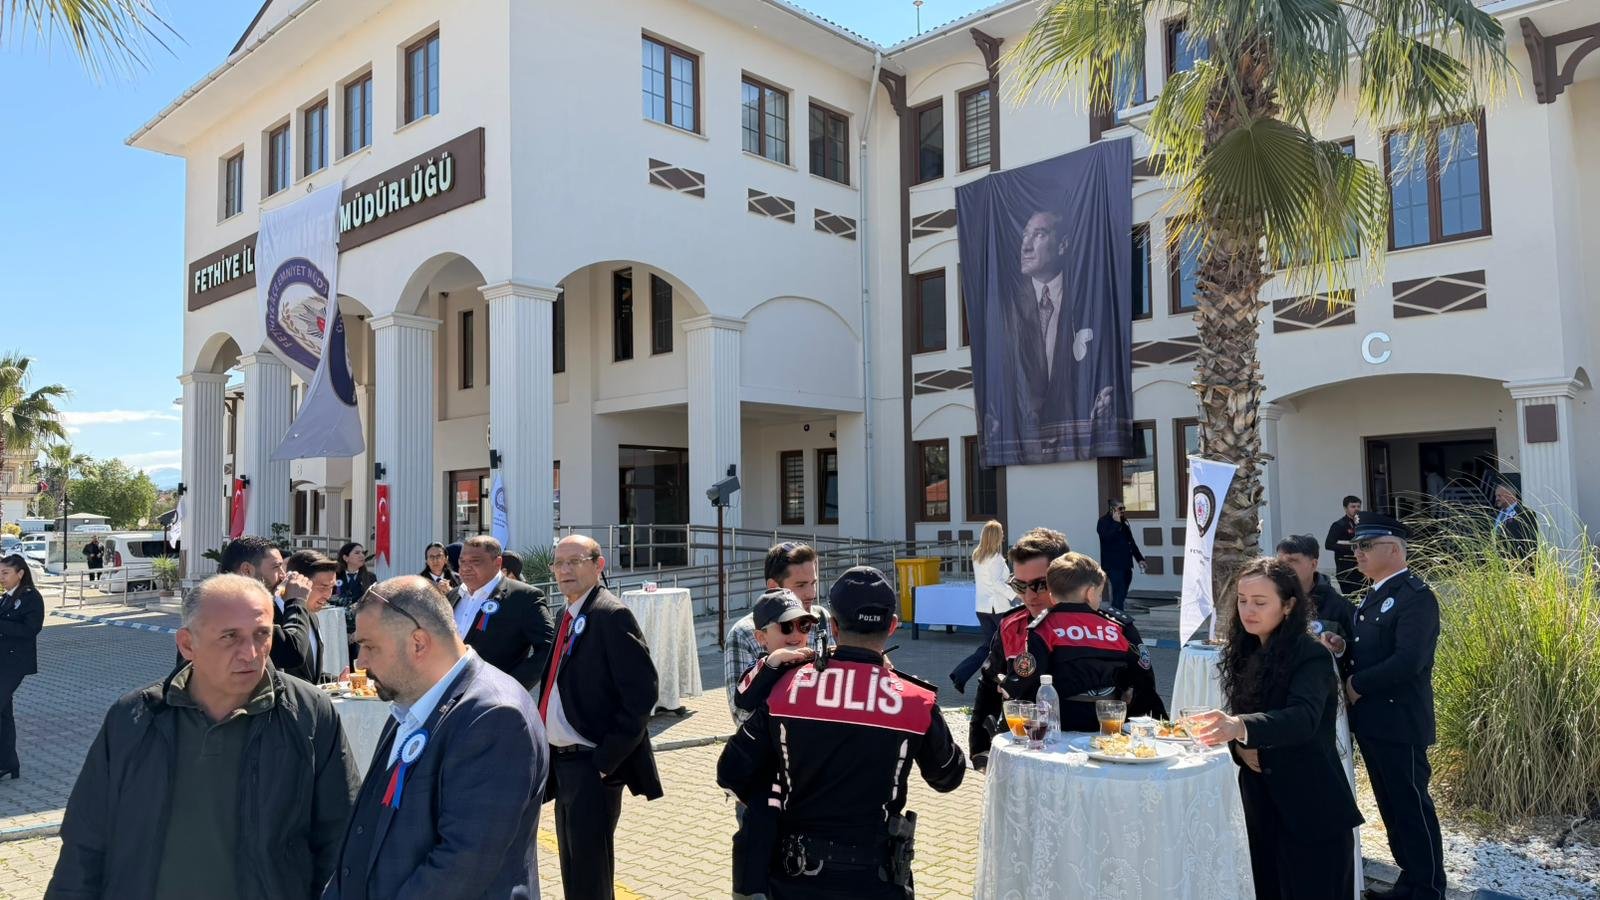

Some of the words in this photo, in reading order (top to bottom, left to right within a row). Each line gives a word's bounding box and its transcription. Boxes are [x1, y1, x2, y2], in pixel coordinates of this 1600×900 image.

[194, 254, 240, 294] FETHİYE
[243, 244, 254, 275] İL
[340, 151, 452, 233] MÜDÜRLÜĞÜ
[1361, 331, 1391, 364] C
[788, 666, 904, 715] POLİS
